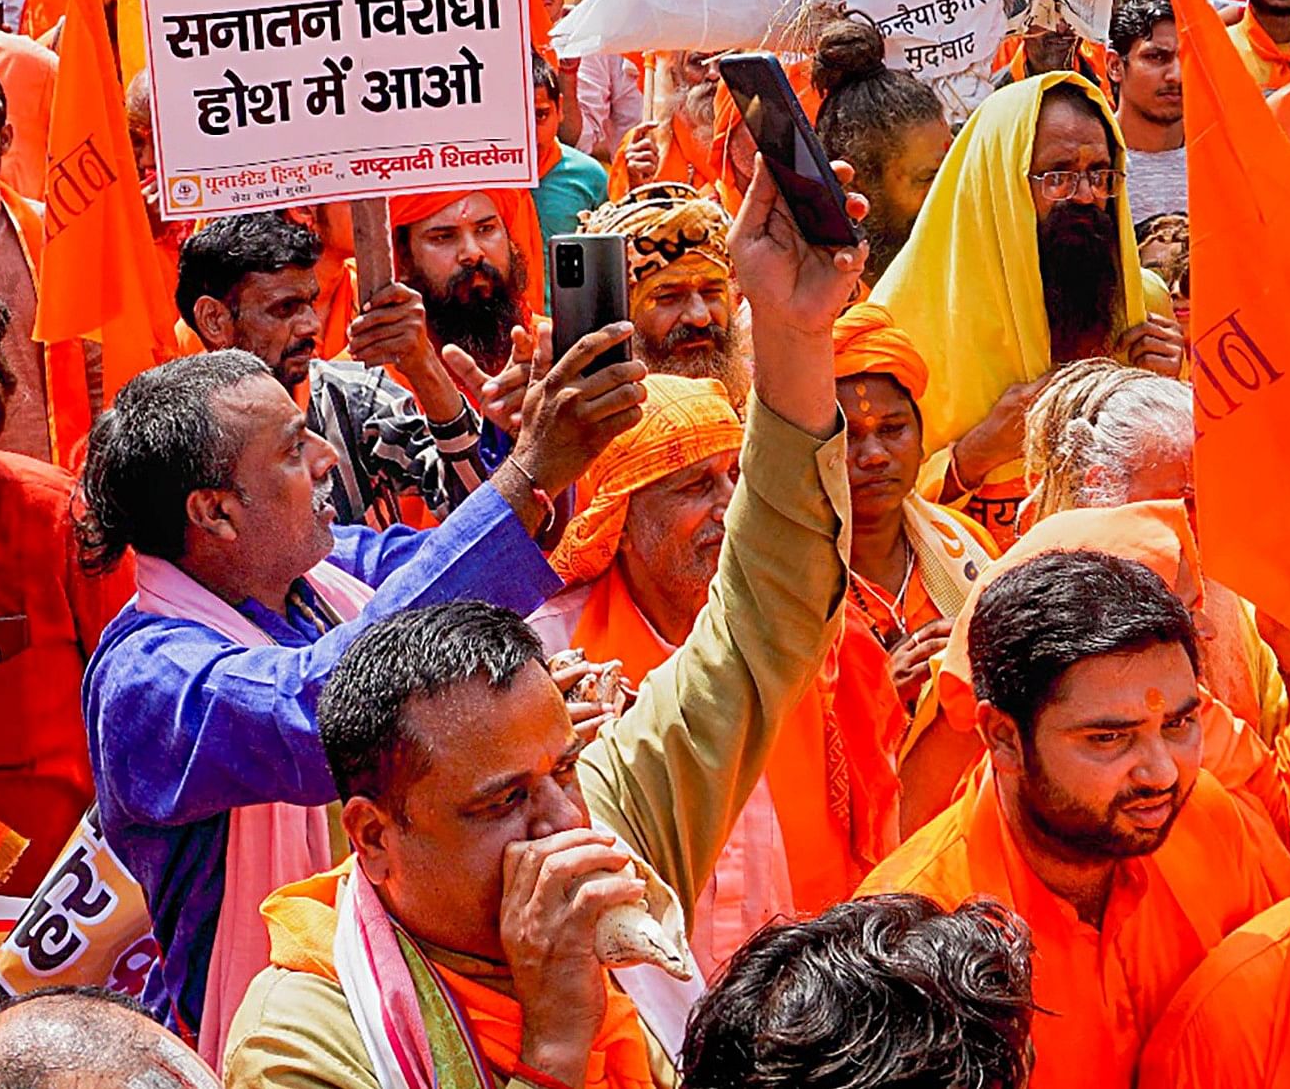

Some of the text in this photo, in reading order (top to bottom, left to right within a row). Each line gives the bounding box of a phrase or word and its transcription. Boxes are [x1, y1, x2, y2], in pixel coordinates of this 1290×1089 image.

[193, 45, 485, 136] होश में आओ
[349, 148, 435, 181] राष्ट्रवादी
[440, 143, 525, 168] शिवसेना
